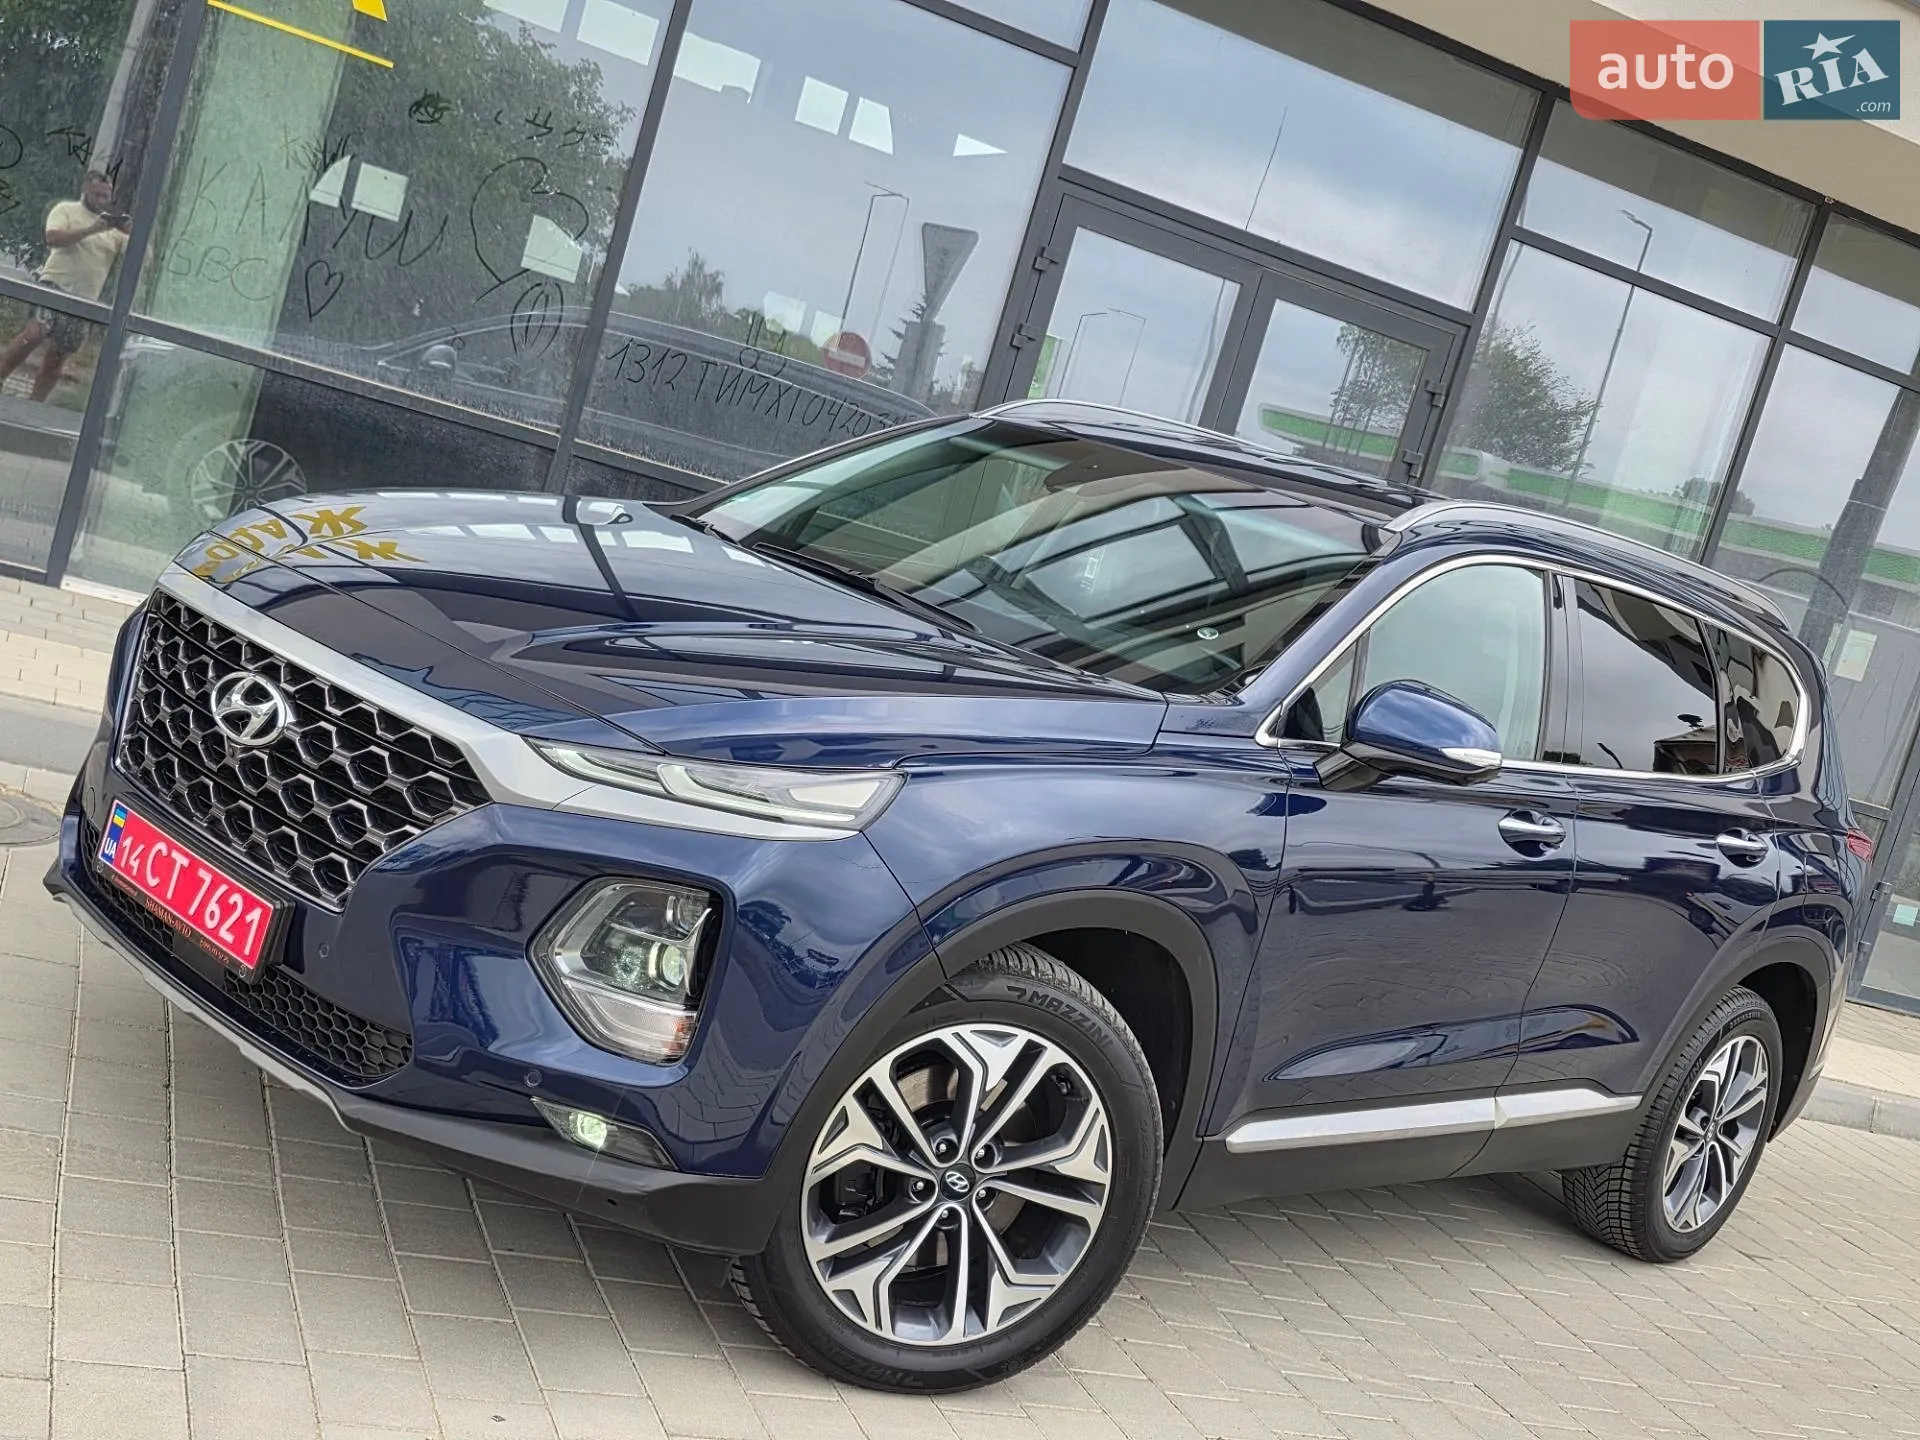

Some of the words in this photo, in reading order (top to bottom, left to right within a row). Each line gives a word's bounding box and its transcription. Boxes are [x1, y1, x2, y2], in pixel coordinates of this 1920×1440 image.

[104, 837, 116, 859] UA
[188, 867, 263, 956] 7621
[1027, 990, 1114, 1049] MAZZINI
